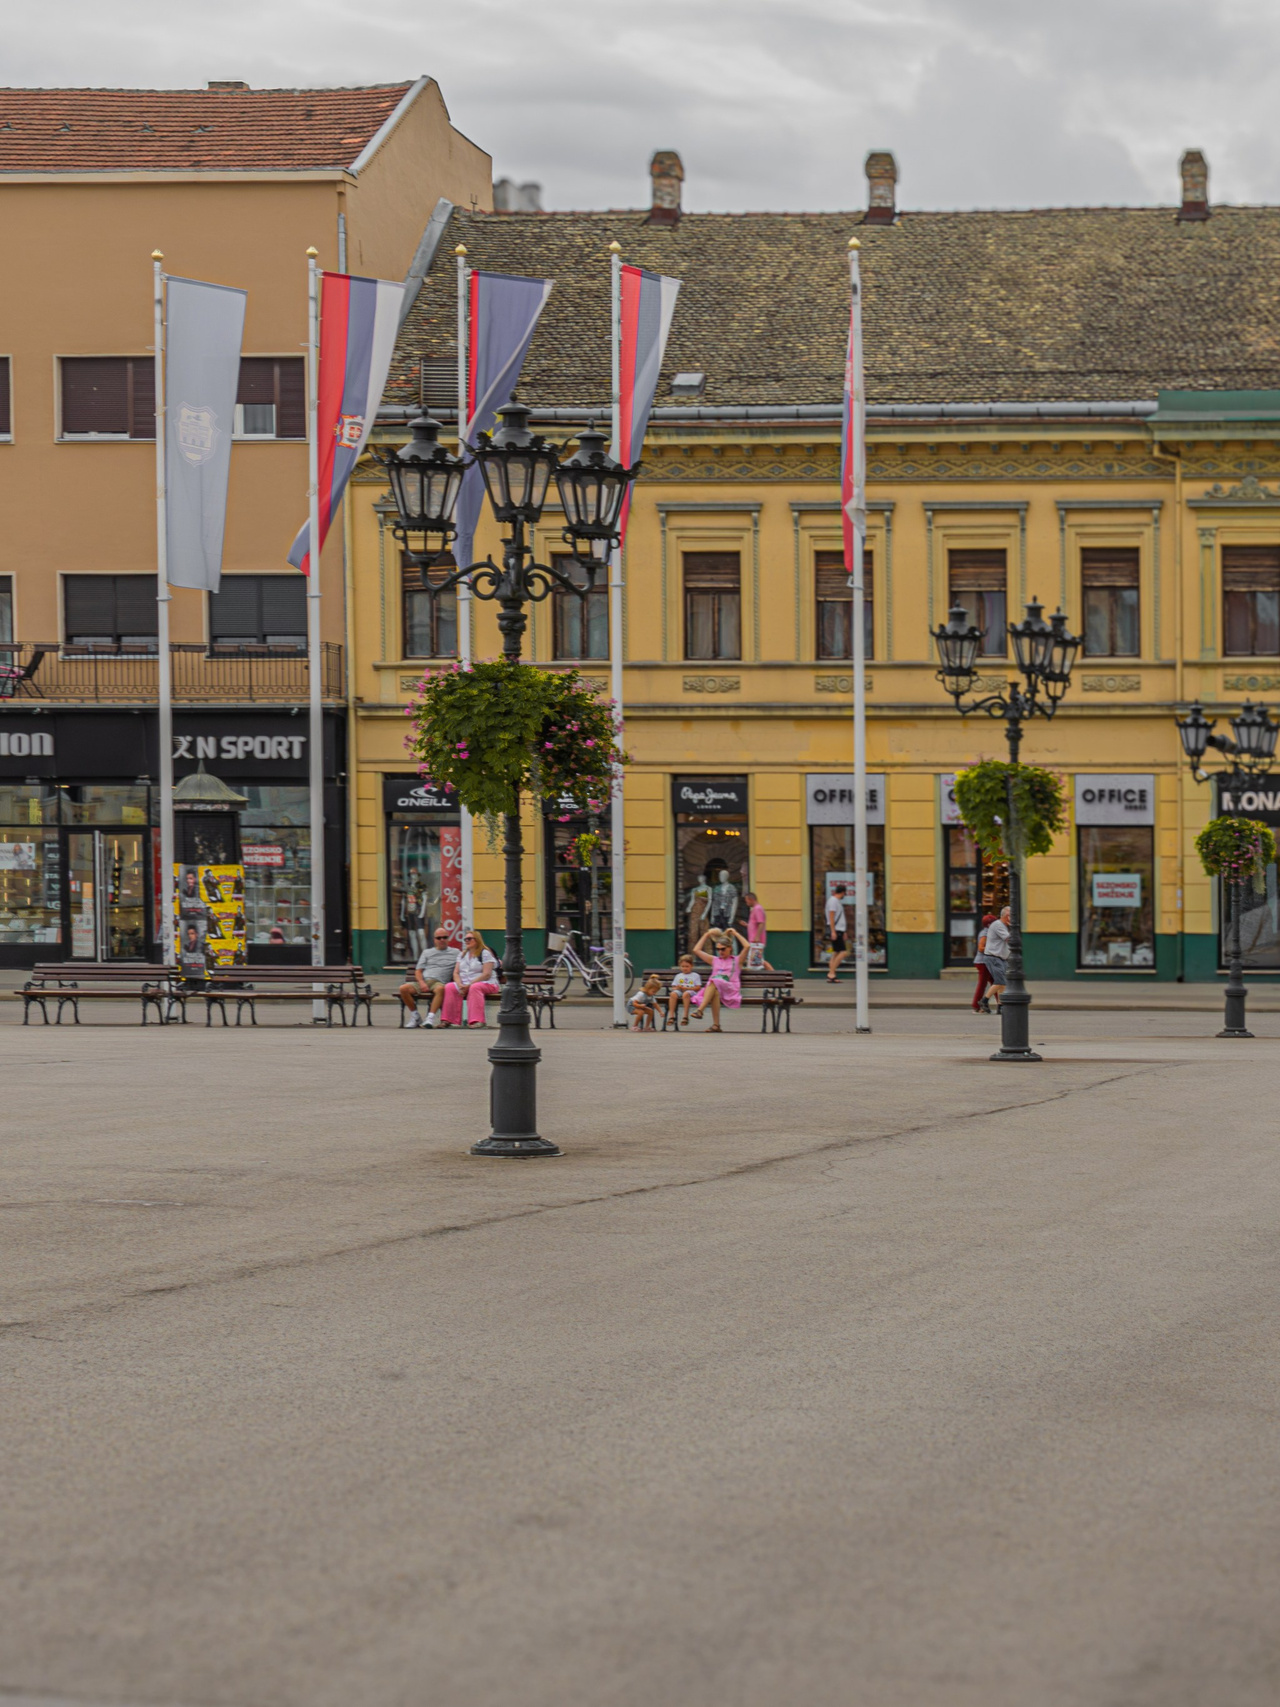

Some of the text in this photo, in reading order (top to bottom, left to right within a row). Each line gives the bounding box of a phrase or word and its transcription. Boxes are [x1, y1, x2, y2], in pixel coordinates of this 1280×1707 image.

[220, 735, 307, 759] SPORT
[813, 788, 878, 803] OFFIE
[1082, 788, 1147, 804] OFFICE
